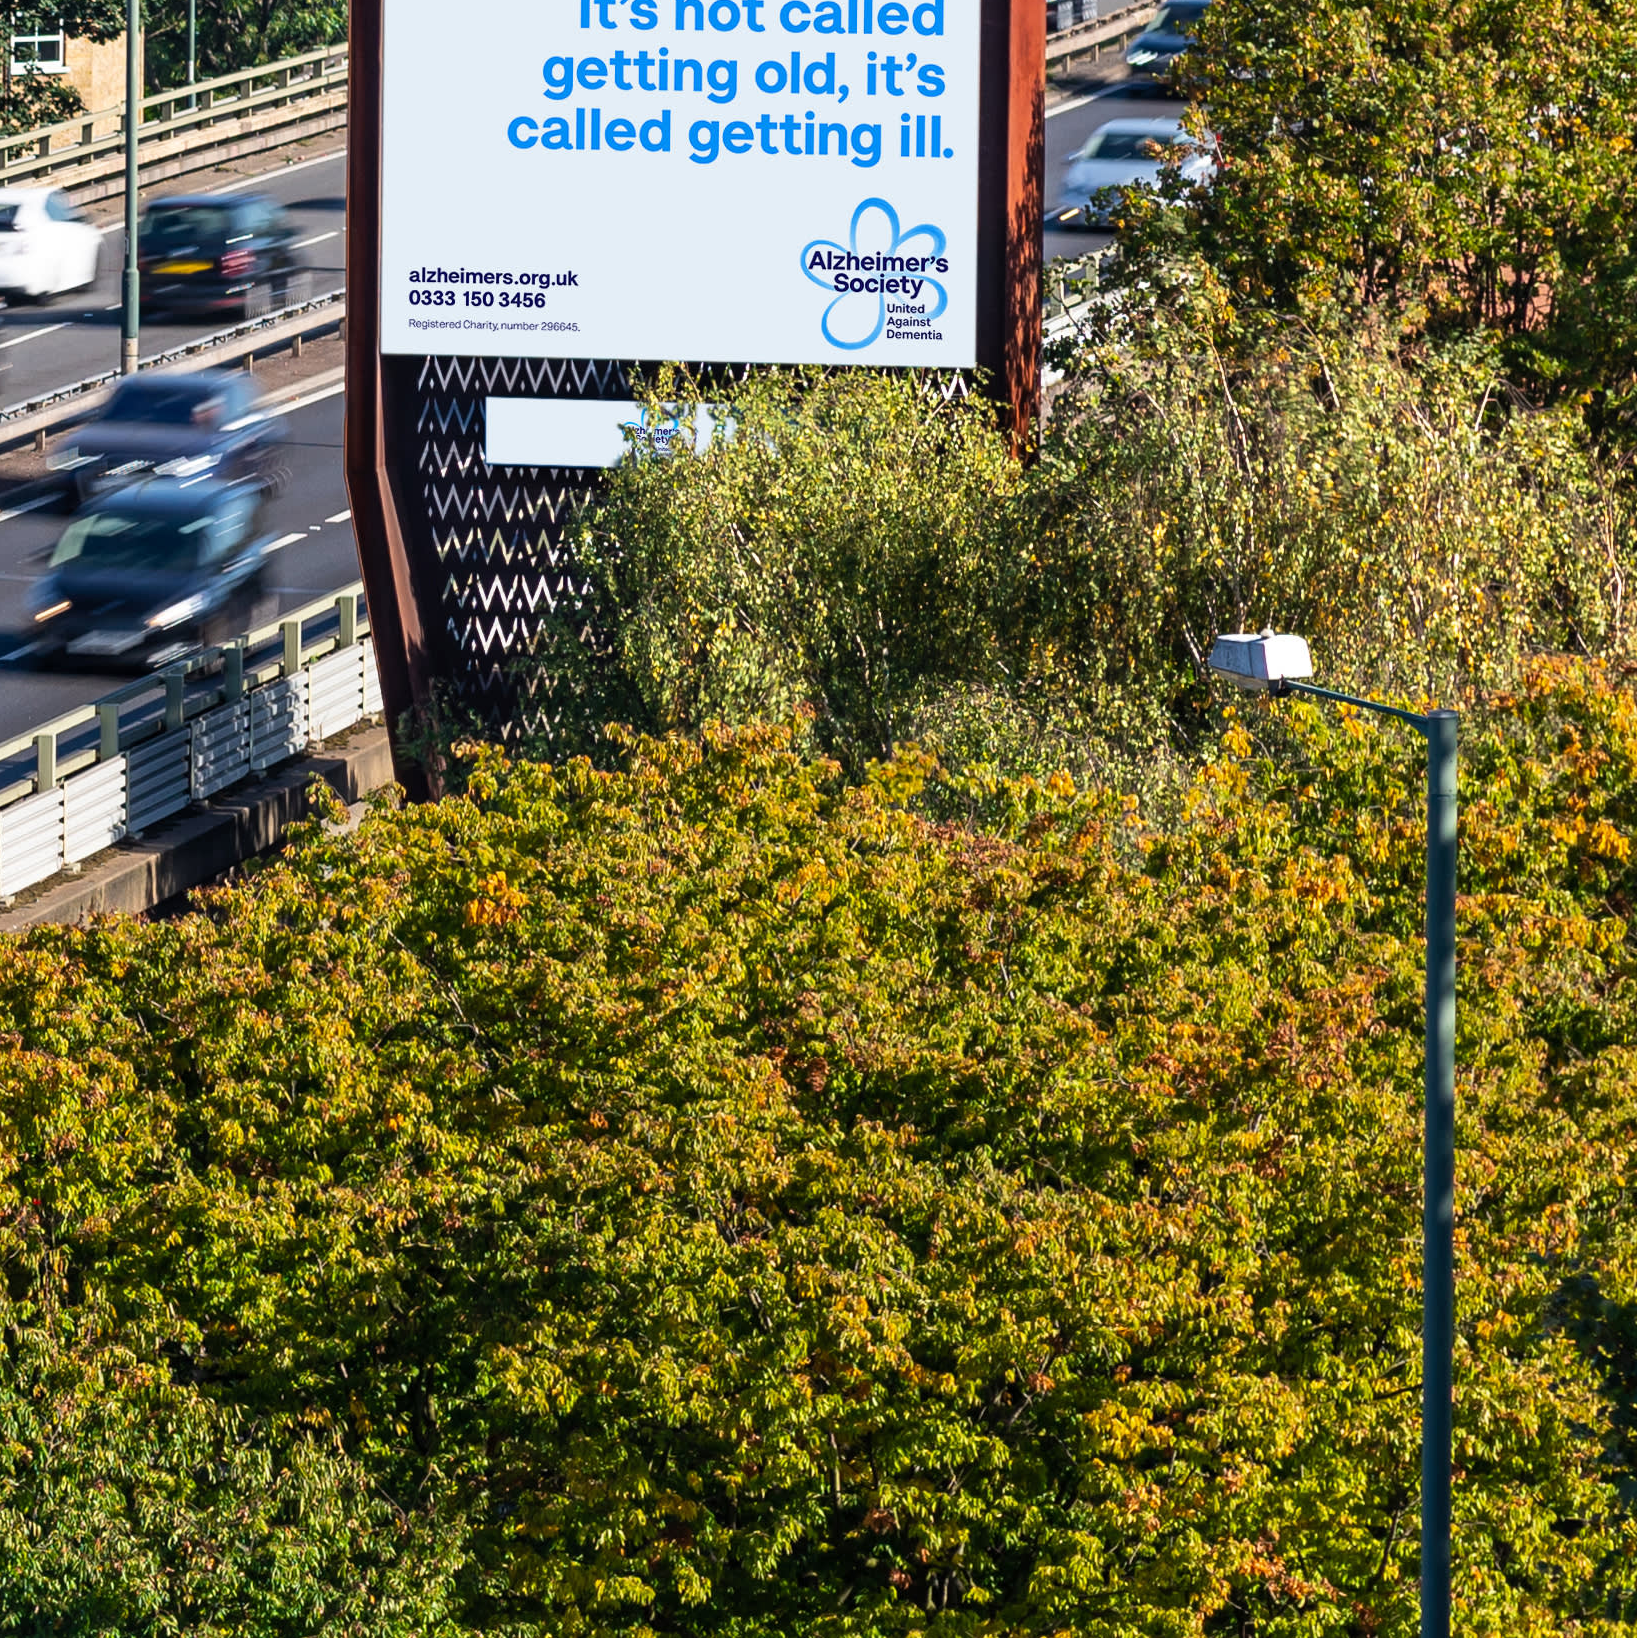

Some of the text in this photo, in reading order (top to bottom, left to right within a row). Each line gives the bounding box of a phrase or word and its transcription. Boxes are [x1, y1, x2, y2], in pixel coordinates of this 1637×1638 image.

[543, 47, 945, 104] getting old, it’s
[507, 107, 954, 168] called getting ill.
[807, 250, 949, 273] Alzheimer’s
[409, 267, 578, 293] alzheimers.org.uk
[834, 273, 923, 297] Society
[409, 290, 545, 308] 0333 150 3456
[887, 304, 925, 314] United
[887, 316, 931, 331] Against
[887, 326, 942, 340] Dementia
